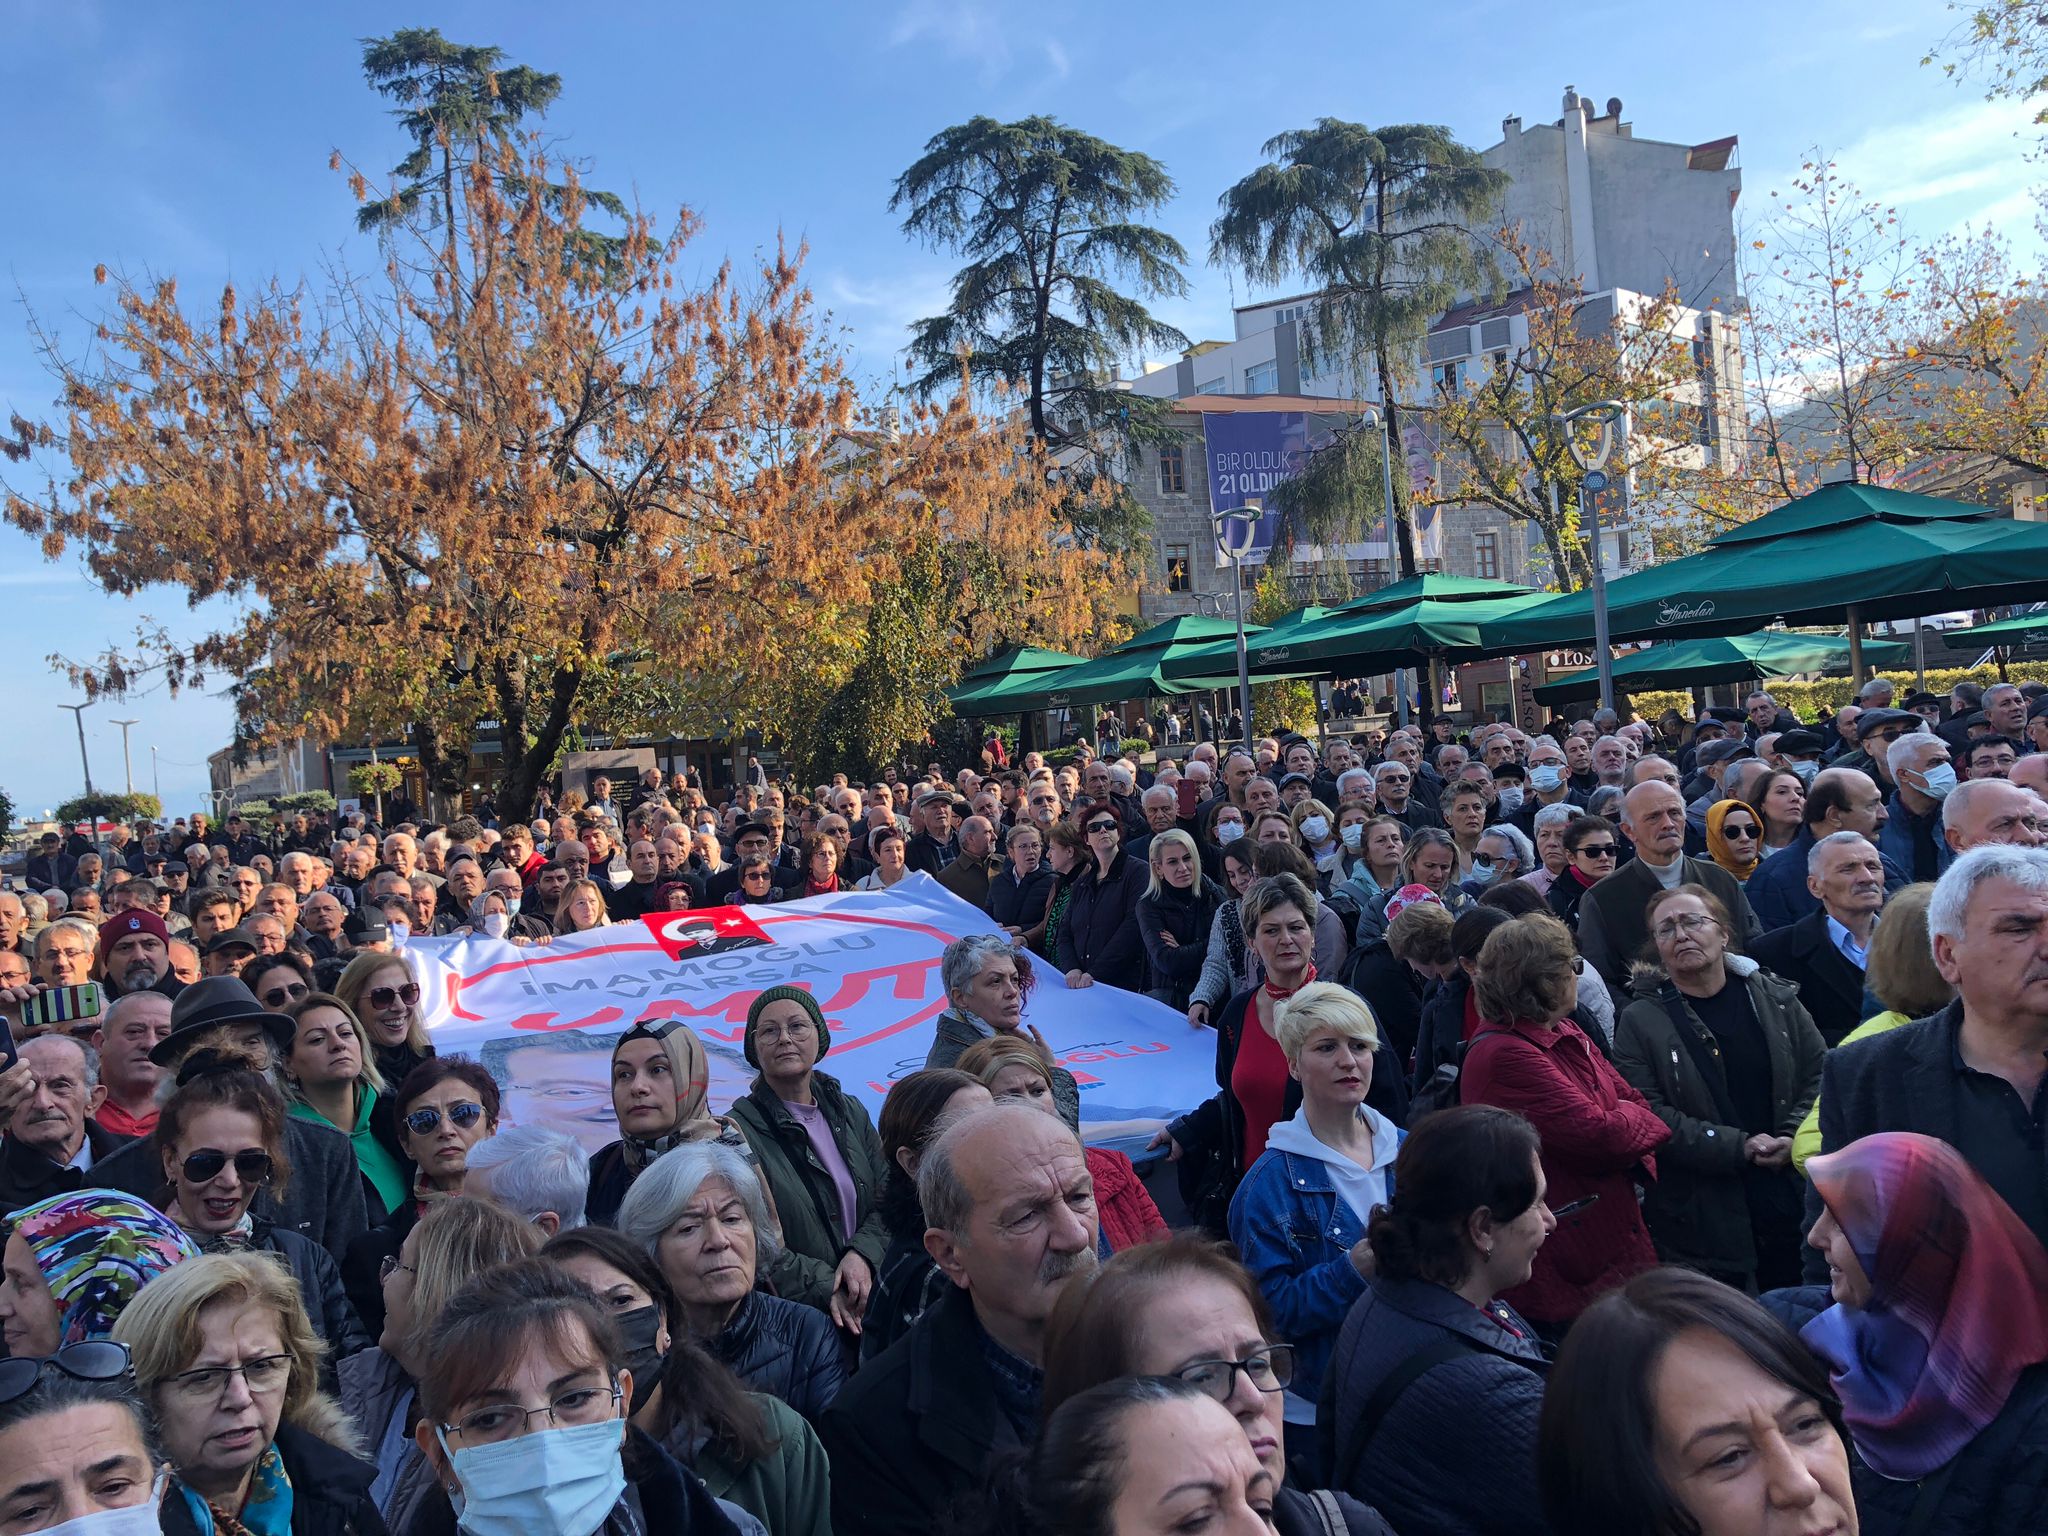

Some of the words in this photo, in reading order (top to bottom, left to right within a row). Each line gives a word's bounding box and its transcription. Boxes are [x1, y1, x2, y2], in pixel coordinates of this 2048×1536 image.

[1243, 451, 1291, 470] OLDUK
[1218, 474, 1236, 495] 21
[1660, 600, 1715, 625] Hanedan
[1520, 668, 1534, 729] OSTRA
[608, 962, 834, 998] VARSA
